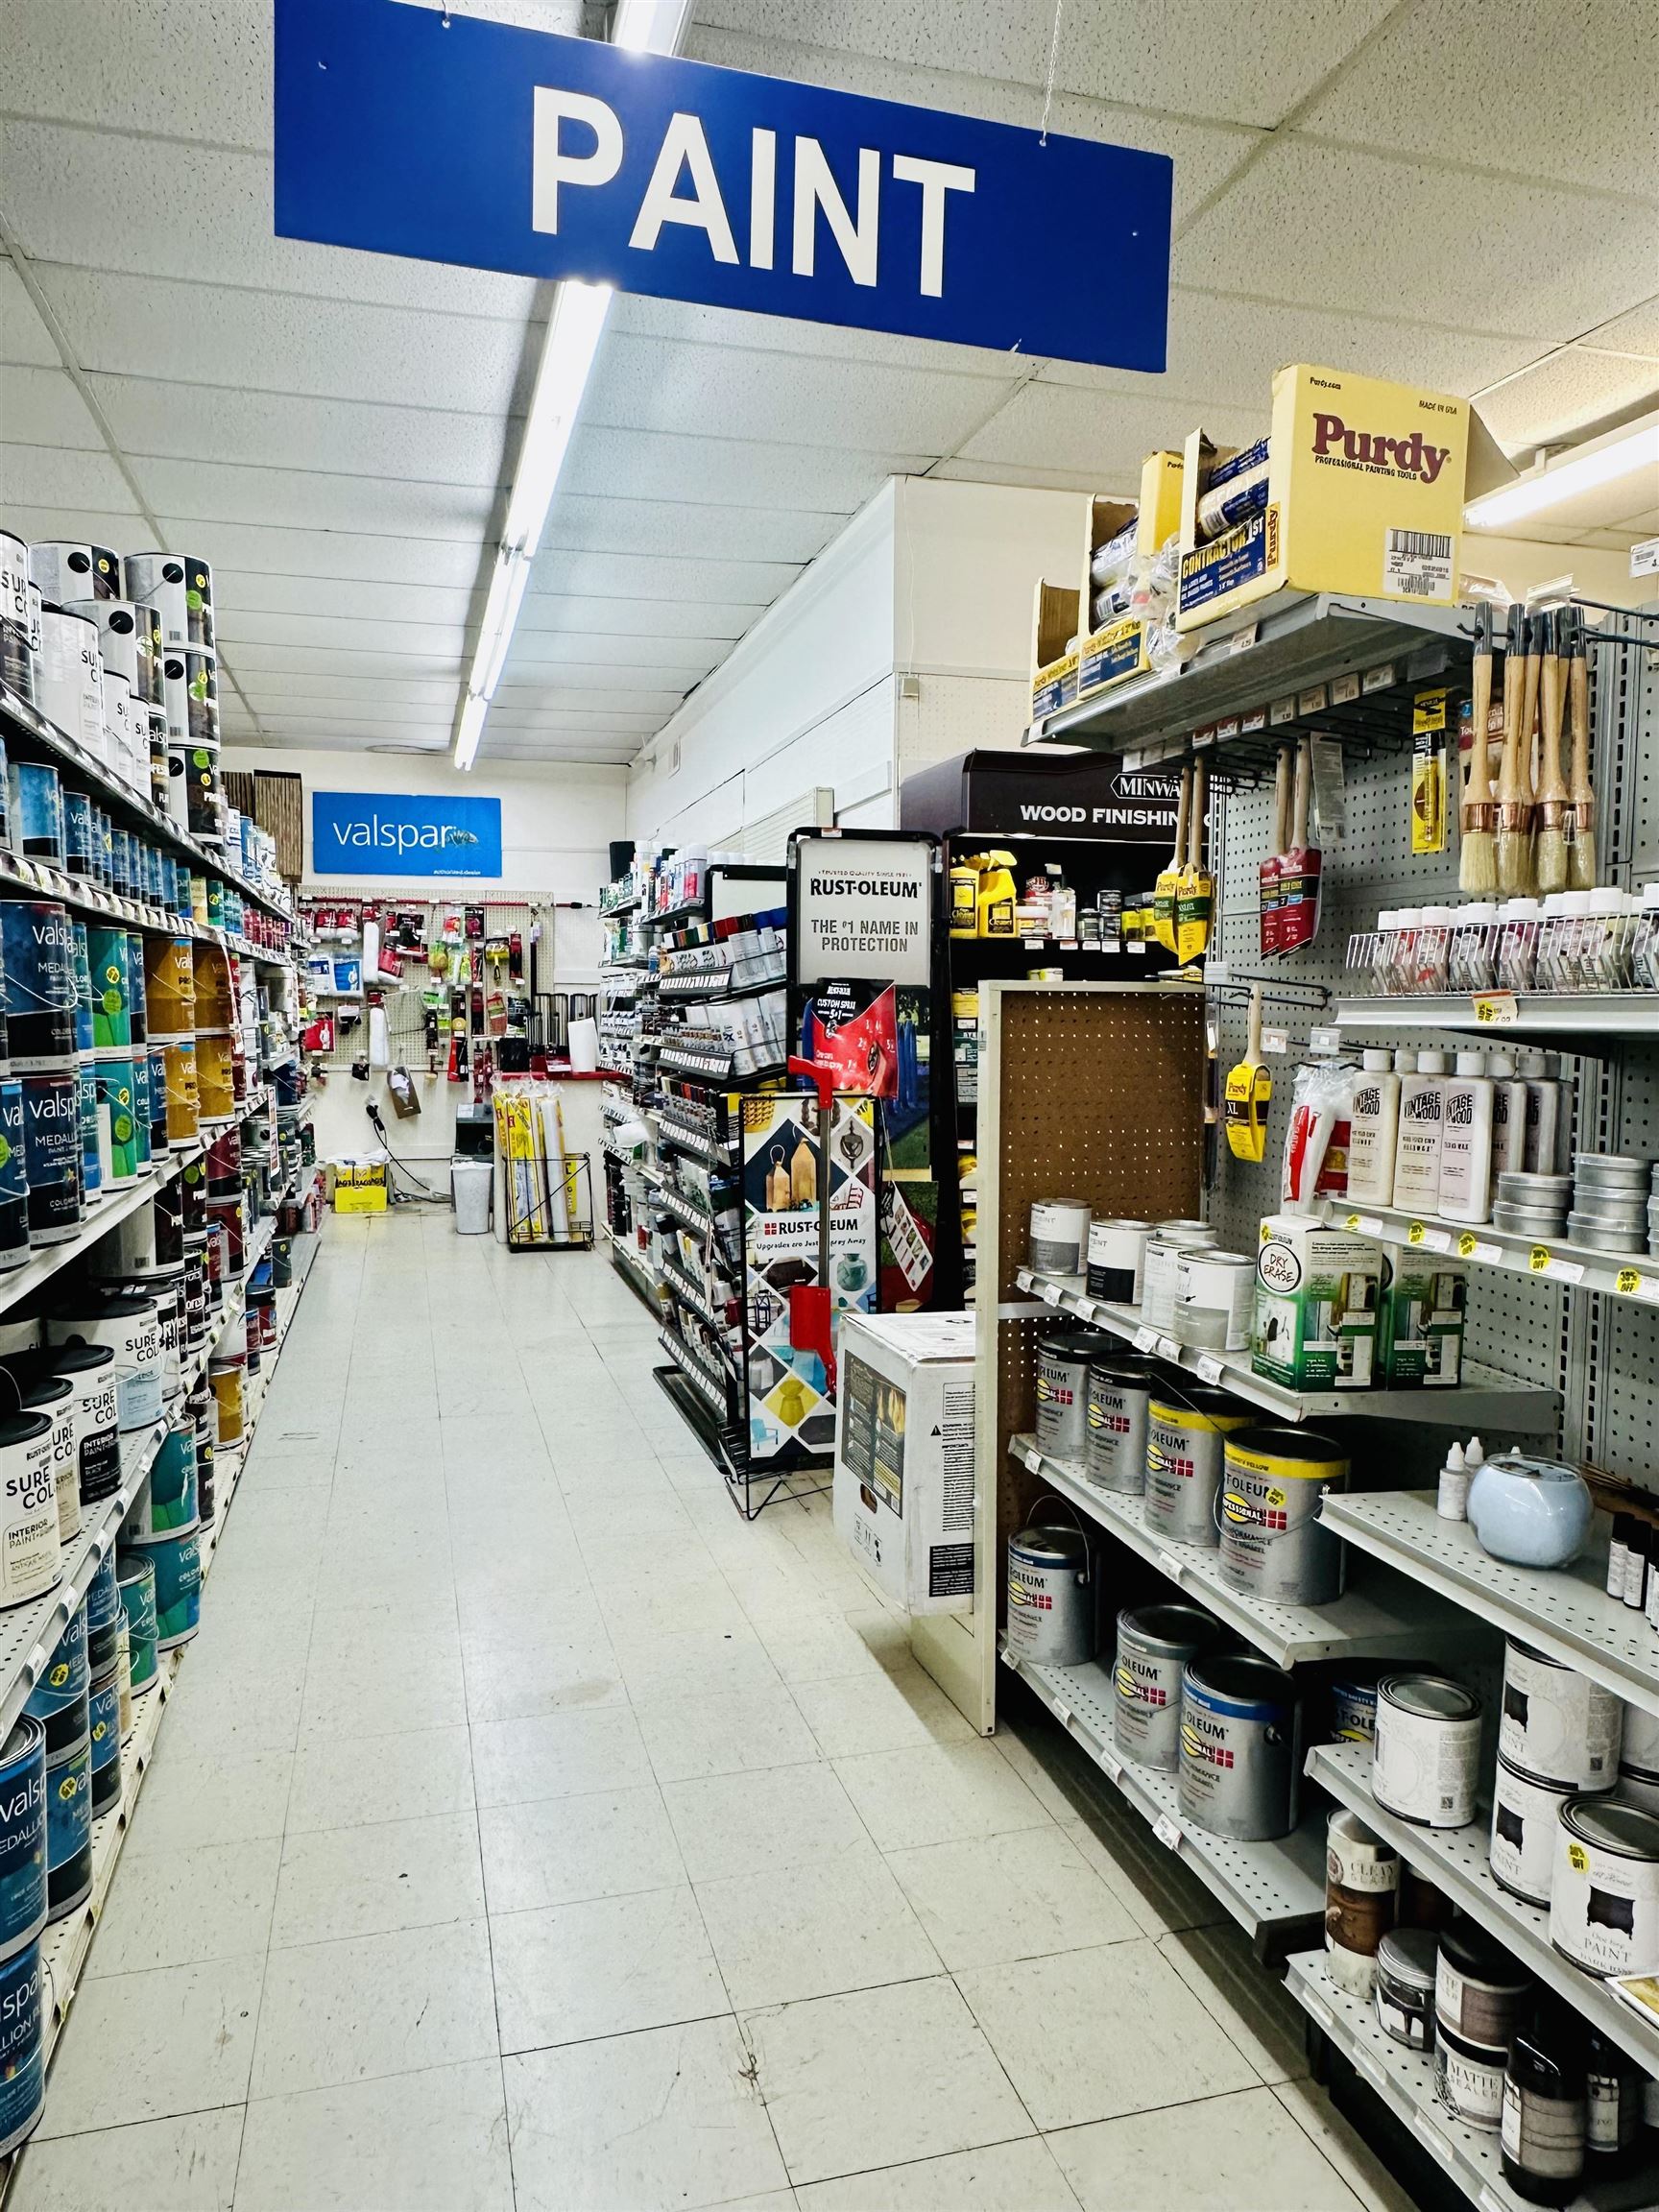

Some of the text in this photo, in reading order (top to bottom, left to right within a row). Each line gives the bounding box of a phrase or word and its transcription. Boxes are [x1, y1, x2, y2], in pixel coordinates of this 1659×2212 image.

[532, 85, 975, 298] PAINT
[1419, 400, 1436, 411] MADE
[1311, 413, 1451, 484] Purdy
[1314, 455, 1417, 480] PROFESSIONAL PAINTING TOOLS
[1120, 777, 1180, 797] MINWA
[1020, 805, 1180, 826] WOOD FINISHIN
[333, 814, 457, 854] valspar
[810, 878, 919, 899] RUST-OLEUM
[811, 919, 837, 933] THE
[860, 920, 901, 935] NAME
[905, 921, 919, 935] IN
[822, 937, 907, 952] PROTECTION
[1227, 1101, 1238, 1115] XL
[779, 1218, 858, 1235] RUST-OEUM
[757, 1241, 790, 1250] Upgrades
[1270, 1253, 1288, 1268] DRY
[1263, 1264, 1295, 1283] ERASE
[126, 1333, 156, 1352] SURE
[52, 1422, 74, 1446] URE
[6, 1466, 50, 1497] SURE
[9, 1519, 48, 1540] INTERIOR
[1351, 1863, 1393, 1876] CLEAN
[1584, 1937, 1632, 1963] PAINT
[1452, 2063, 1499, 2089] MATTE
